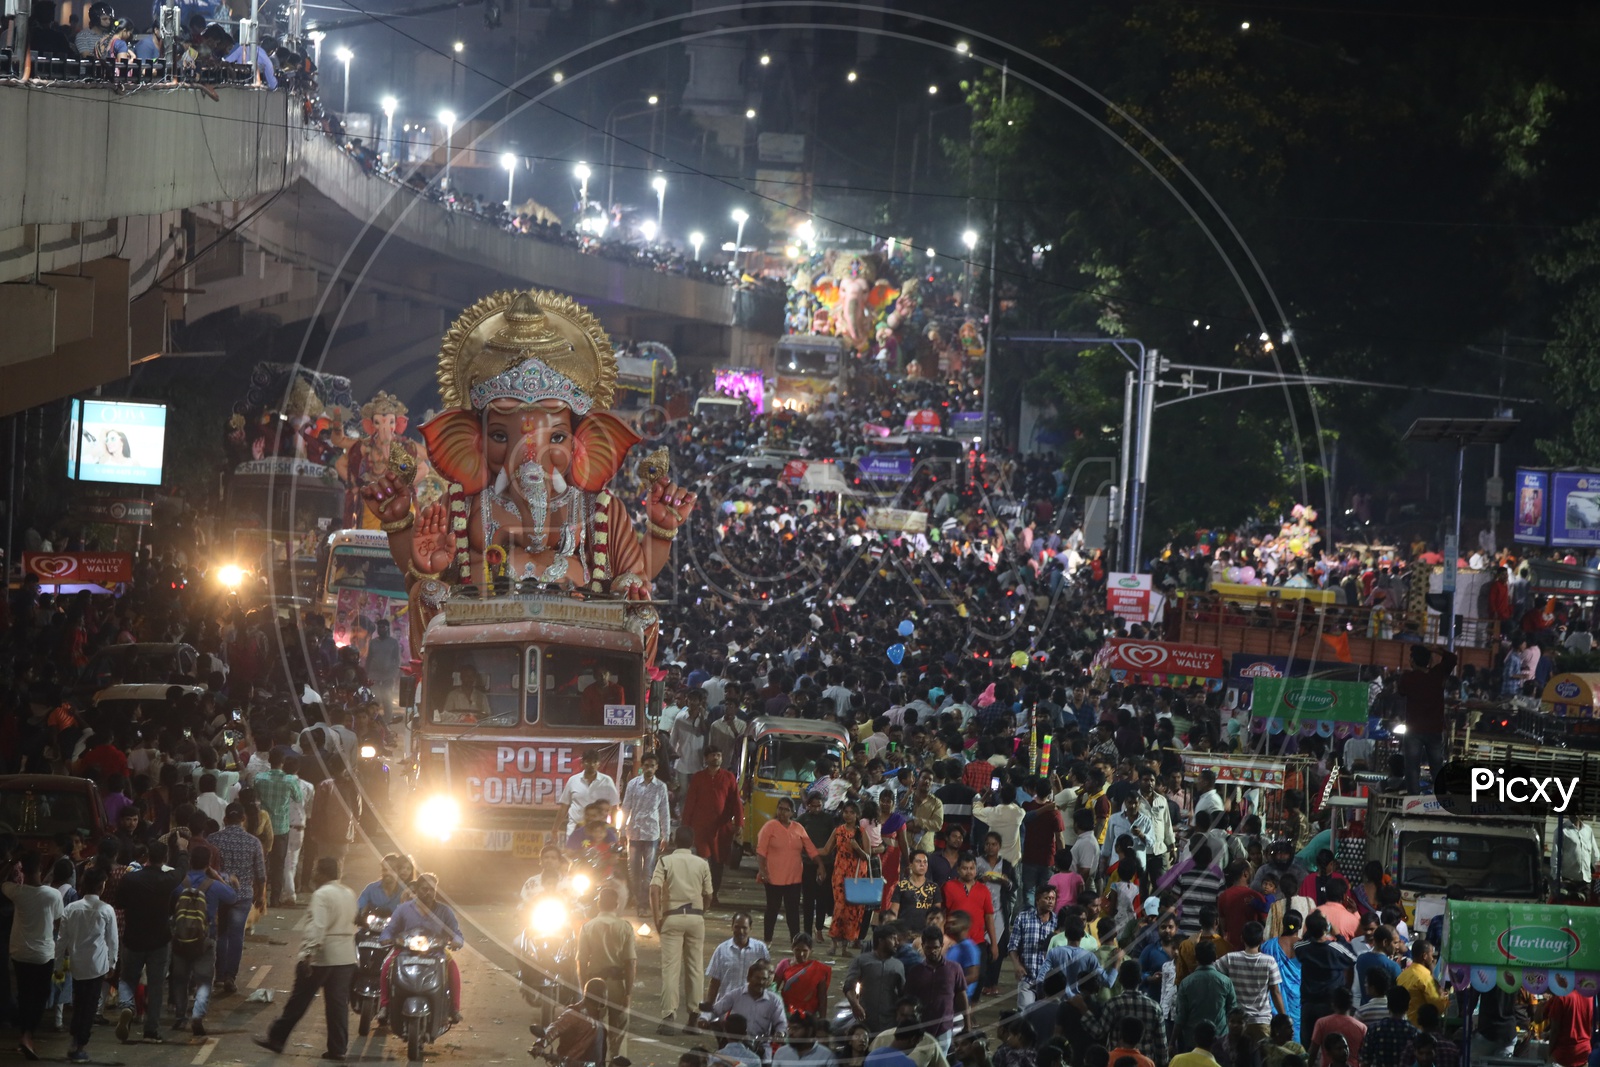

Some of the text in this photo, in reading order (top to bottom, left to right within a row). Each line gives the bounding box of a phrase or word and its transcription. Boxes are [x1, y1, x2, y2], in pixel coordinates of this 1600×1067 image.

[871, 459, 899, 468] Amul
[86, 565, 118, 573] WALL'S
[1568, 580, 1582, 589] BELT
[1172, 649, 1215, 661] KWALITY
[1176, 658, 1209, 670] WALL'S
[1290, 693, 1333, 705] Heritage
[496, 746, 572, 774] POTE
[916, 902, 932, 910] DAY
[1508, 935, 1571, 953] Heritage
